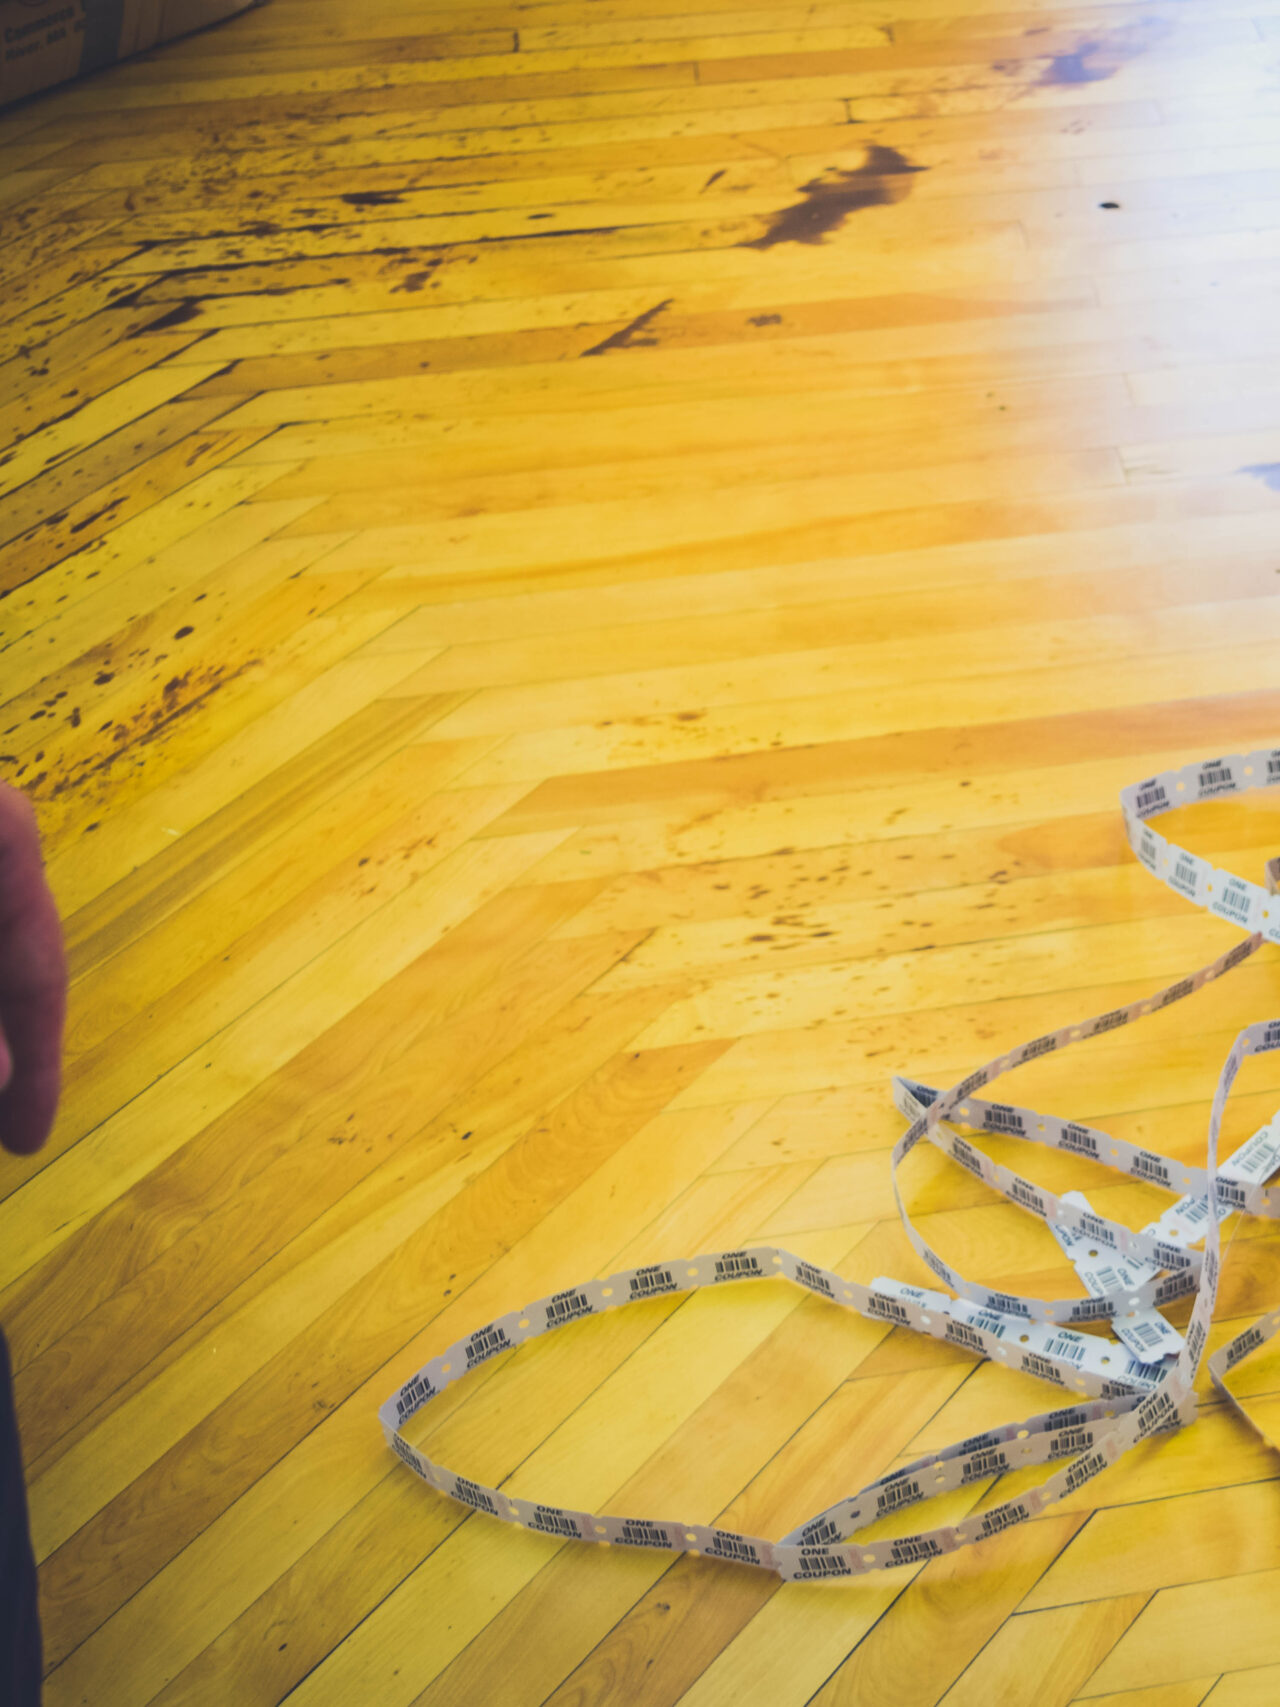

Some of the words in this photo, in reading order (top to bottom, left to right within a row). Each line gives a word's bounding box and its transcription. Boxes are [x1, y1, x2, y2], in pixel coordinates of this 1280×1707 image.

[1229, 878, 1247, 890] ONE
[1212, 901, 1248, 924] COUPON
[991, 1104, 1015, 1113] ONE
[983, 1121, 1027, 1136] COUPON
[1067, 1123, 1090, 1134] ONE
[954, 1137, 973, 1152] ONE
[1058, 1140, 1100, 1160] COUPON
[1139, 1151, 1161, 1163] ONE
[1015, 1177, 1035, 1191] ONE
[1130, 1167, 1172, 1188] COUPON
[1216, 1176, 1239, 1187] ONE
[1006, 1190, 1047, 1217] COUPON
[1083, 1212, 1105, 1225] ONE
[1072, 1226, 1118, 1250] COUPON
[722, 1251, 747, 1259] ONE
[1157, 1241, 1181, 1254] ONE
[636, 1265, 661, 1276] ONE
[714, 1269, 763, 1282] COUPON
[551, 1288, 577, 1303] ONE
[629, 1283, 678, 1300] COUPON
[874, 1292, 897, 1303] ONE
[900, 1287, 925, 1297] ONE
[1080, 1297, 1105, 1305] ONE
[546, 1305, 593, 1328] COUPON
[867, 1307, 911, 1325] COUPON
[978, 1310, 1003, 1321] ONE
[471, 1324, 494, 1342] ONE
[952, 1320, 975, 1331] ONE
[1057, 1331, 1083, 1342] ONE
[945, 1334, 987, 1355] COUPON
[466, 1339, 511, 1369] COUPON
[1028, 1353, 1051, 1364] ONE
[1021, 1366, 1065, 1386] COUPON
[400, 1374, 420, 1396] ONE
[1110, 1380, 1134, 1390] ONE
[399, 1386, 436, 1425] COUPON
[1138, 1393, 1158, 1414] ONE
[1049, 1408, 1076, 1419] ONE
[1133, 1401, 1174, 1443] COUPON
[1059, 1427, 1085, 1438] ONE
[963, 1434, 989, 1447] ONE
[970, 1448, 996, 1461] ONE
[1048, 1444, 1094, 1460] COUPON
[1068, 1453, 1091, 1472] ONE
[961, 1463, 1010, 1484] COUPON
[1059, 1461, 1107, 1499] COUPON
[457, 1476, 480, 1491] ONE
[884, 1477, 911, 1493] ONE
[450, 1490, 499, 1516] COUPON
[536, 1505, 563, 1516] ONE
[876, 1491, 924, 1518] COUPON
[985, 1503, 1011, 1519] ONE
[528, 1521, 582, 1538] COUPON
[626, 1519, 653, 1527] ONE
[802, 1517, 826, 1536] ONE
[975, 1512, 1030, 1542] COUPON
[614, 1537, 672, 1548] COUPON
[716, 1531, 743, 1542] ONE
[893, 1535, 922, 1547] ONE
[704, 1547, 760, 1565] COUPON
[885, 1549, 942, 1568] COUPON
[793, 1568, 851, 1579] COUPON
